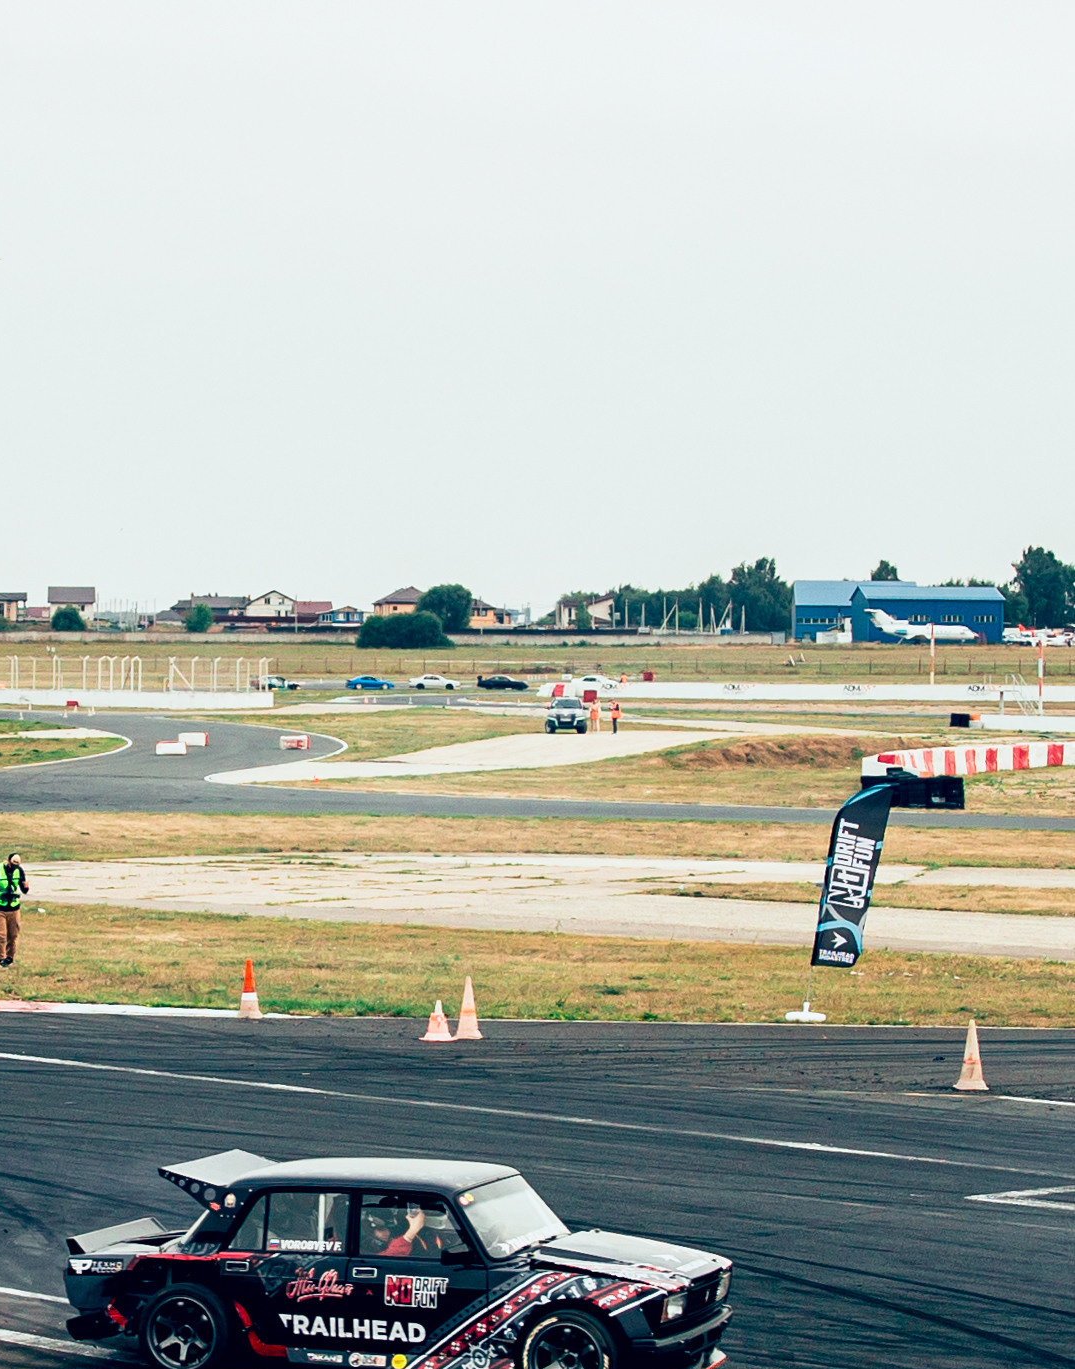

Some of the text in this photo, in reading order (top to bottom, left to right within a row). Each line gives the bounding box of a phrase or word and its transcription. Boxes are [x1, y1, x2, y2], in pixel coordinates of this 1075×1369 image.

[833, 818, 860, 866] DRIFT
[852, 836, 876, 869] FUN
[827, 864, 870, 909] NO
[280, 1239, 333, 1252] VOROBYEV
[385, 1275, 413, 1307] NO
[412, 1276, 449, 1294] DRIFT
[413, 1291, 437, 1309] FUN
[278, 1313, 427, 1343] TRAILHEAD
